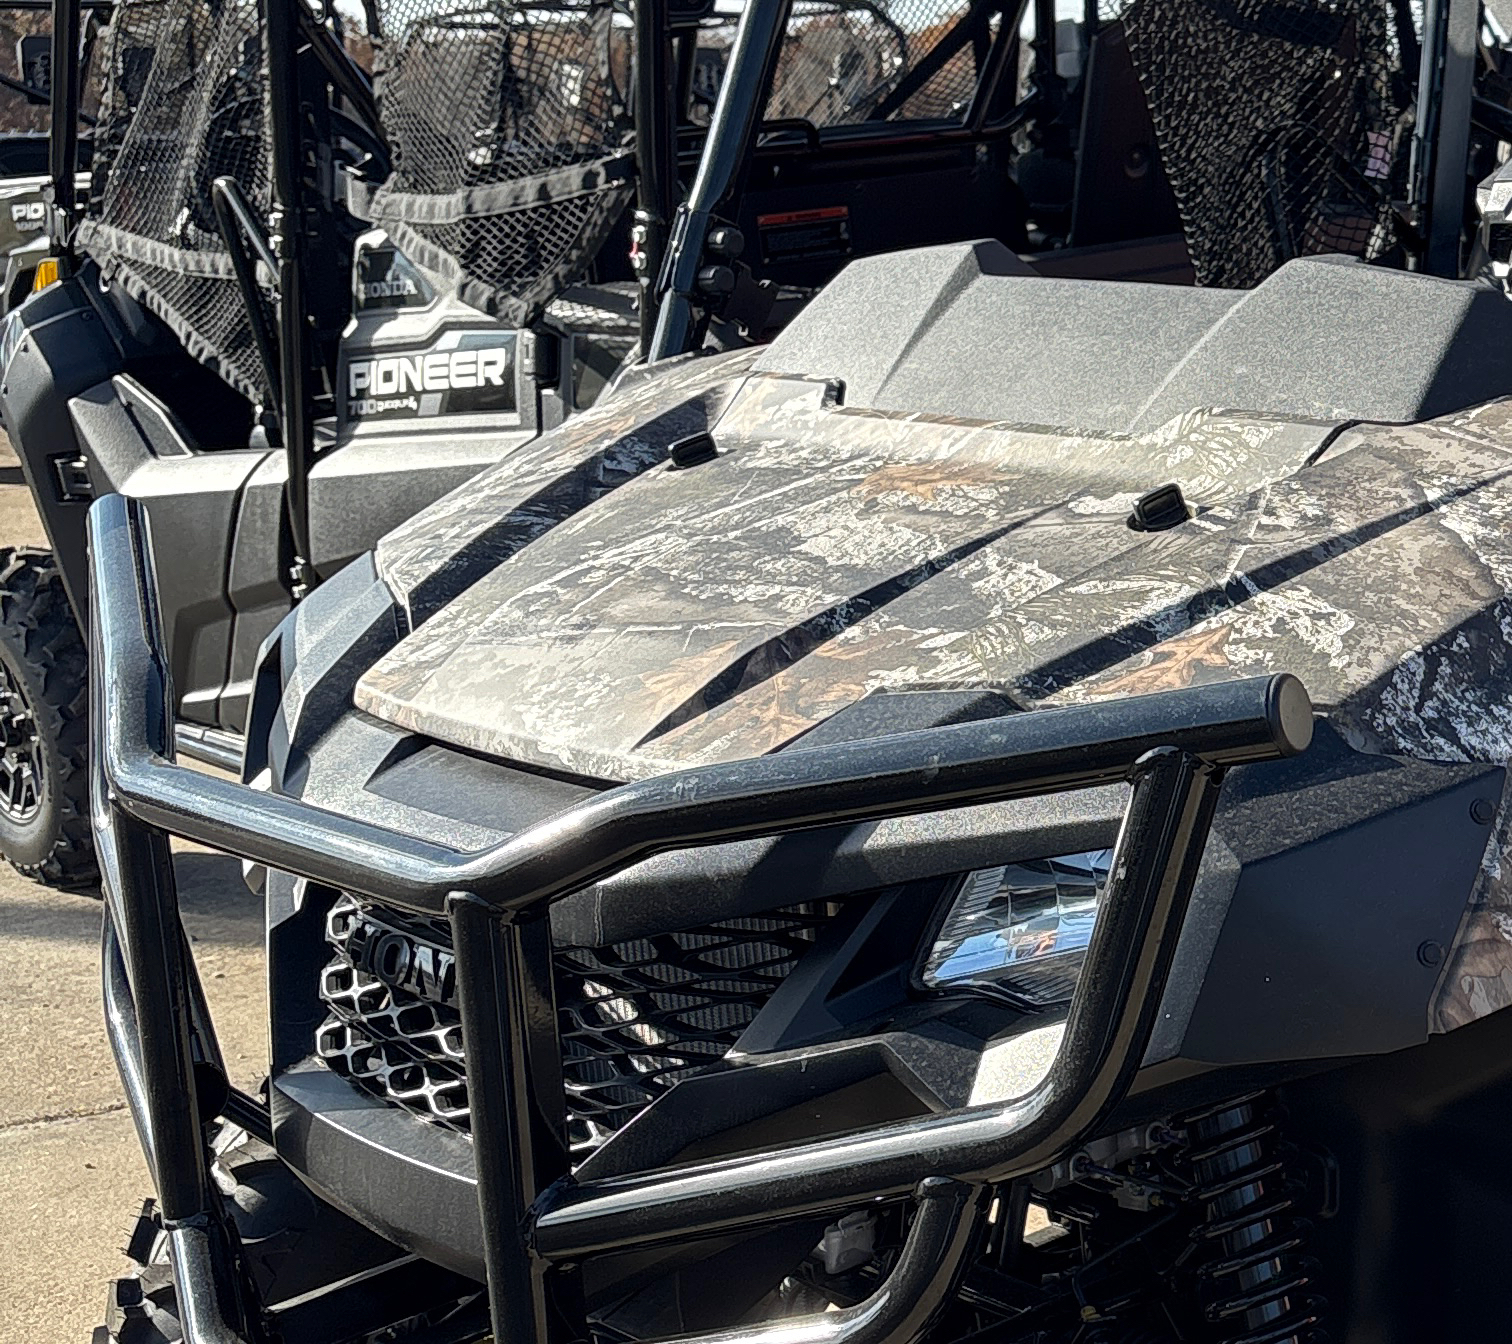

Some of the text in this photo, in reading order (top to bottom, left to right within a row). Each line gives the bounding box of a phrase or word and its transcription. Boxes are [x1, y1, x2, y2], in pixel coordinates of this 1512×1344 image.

[359, 279, 418, 299] HONDA
[350, 348, 505, 396] PIONEER
[349, 398, 377, 415] 700
[348, 916, 458, 1002] HON
